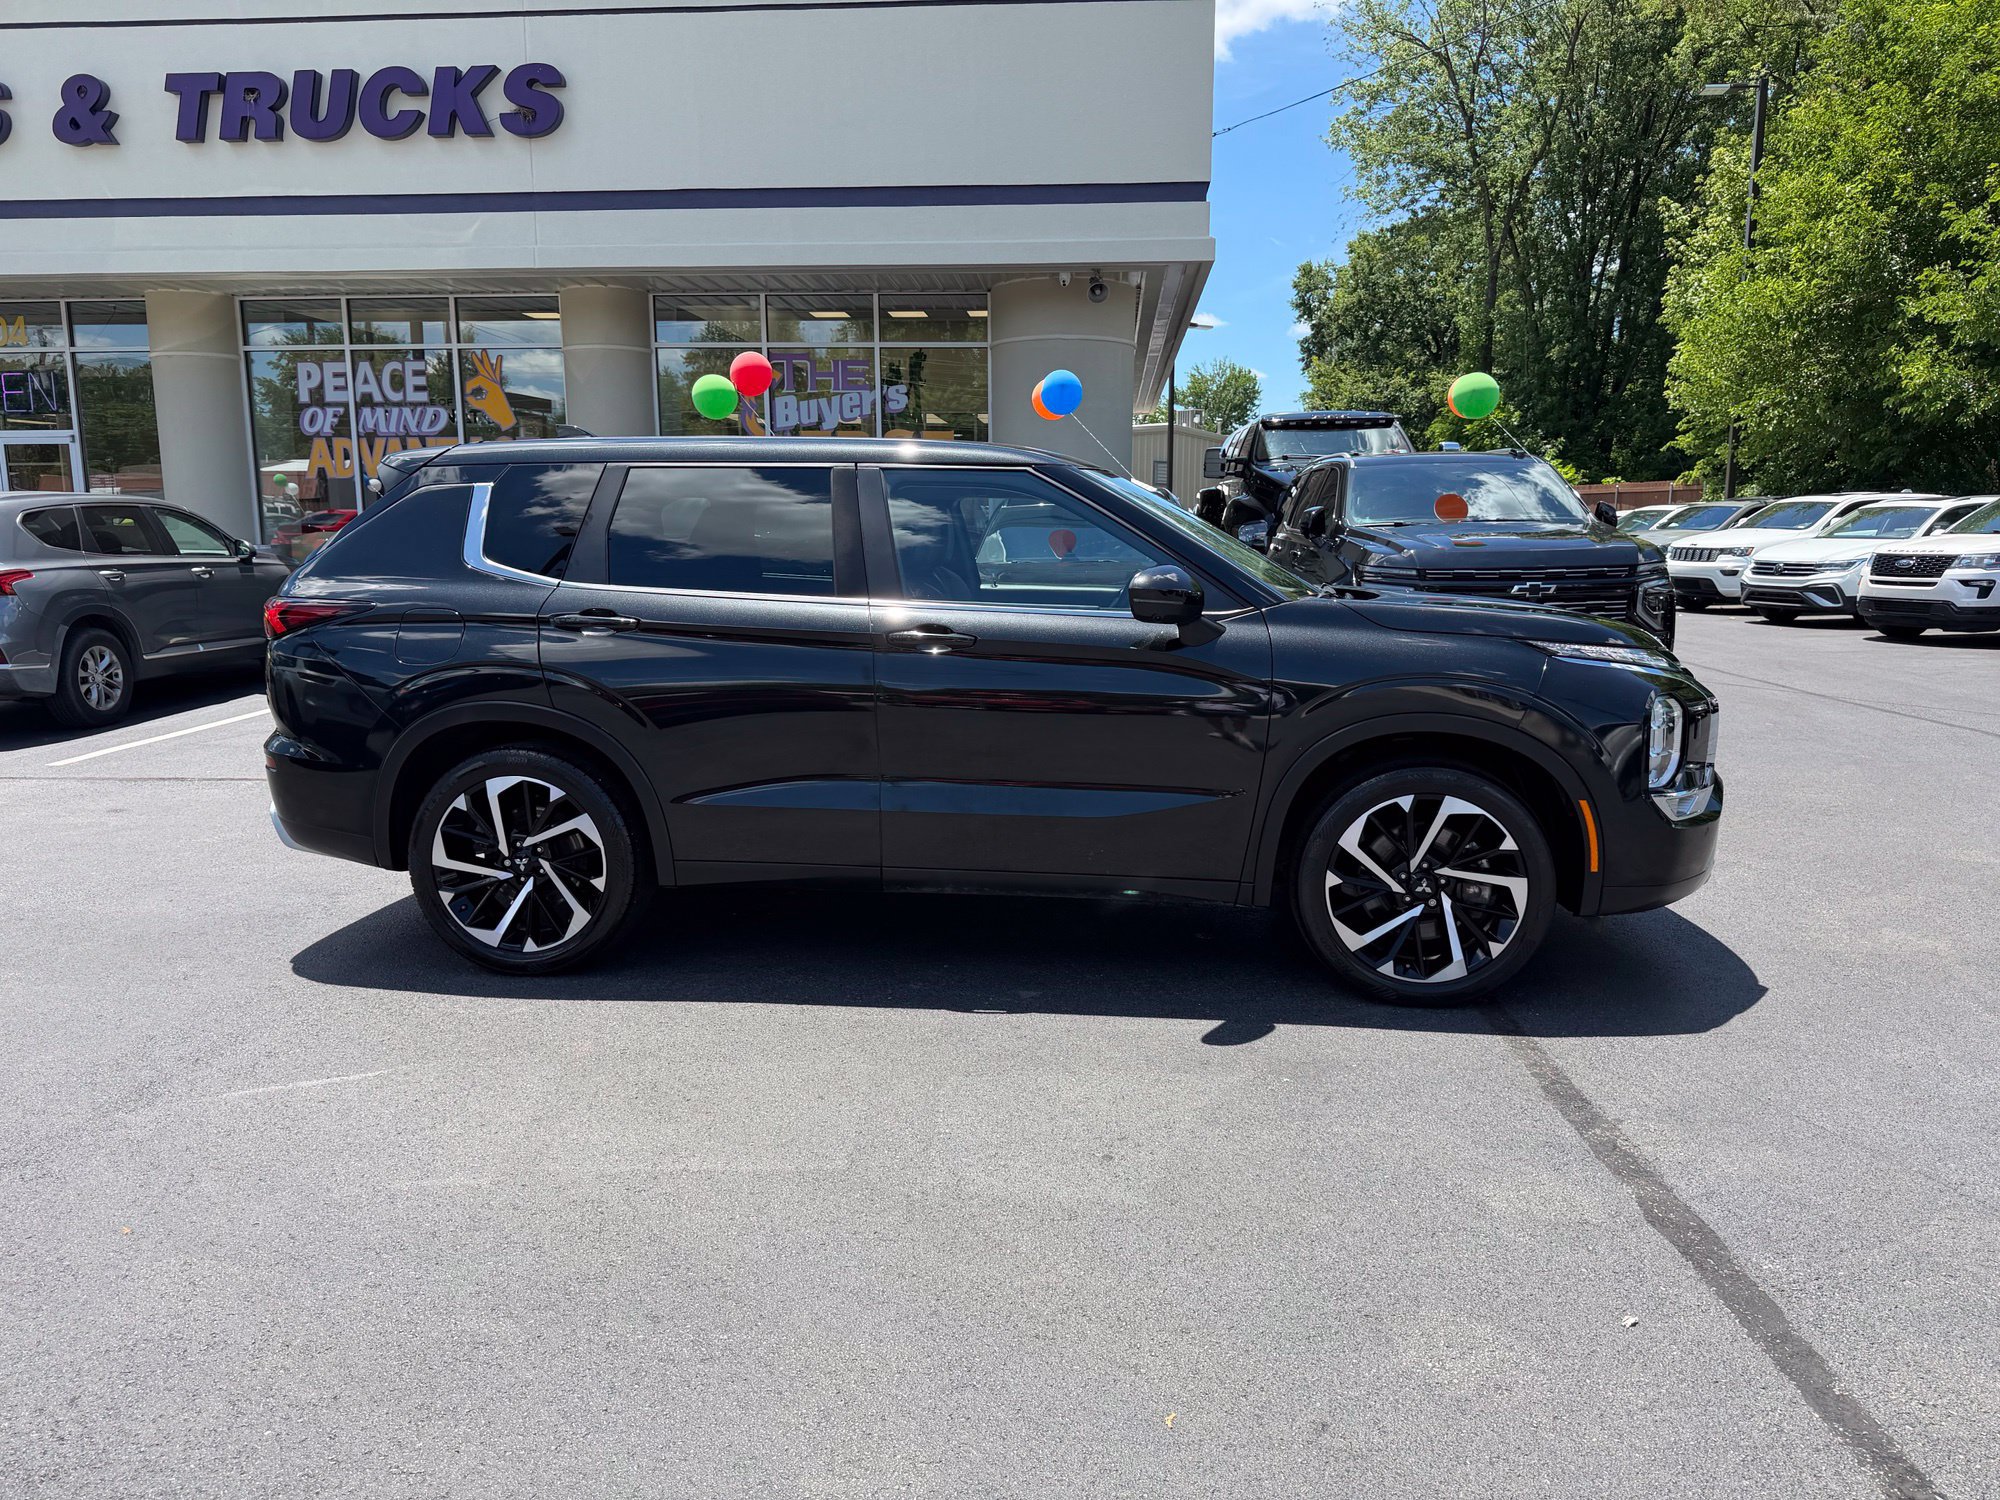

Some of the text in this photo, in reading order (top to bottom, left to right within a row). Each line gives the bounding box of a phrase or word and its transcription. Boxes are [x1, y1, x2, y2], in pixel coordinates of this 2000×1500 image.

[52, 73, 119, 146] &
[165, 62, 567, 144] TRUCKS
[1, 372, 57, 412] EN
[296, 360, 429, 403] PEACE
[768, 352, 870, 393] THE
[300, 406, 344, 436] OF
[358, 405, 449, 436] MIND
